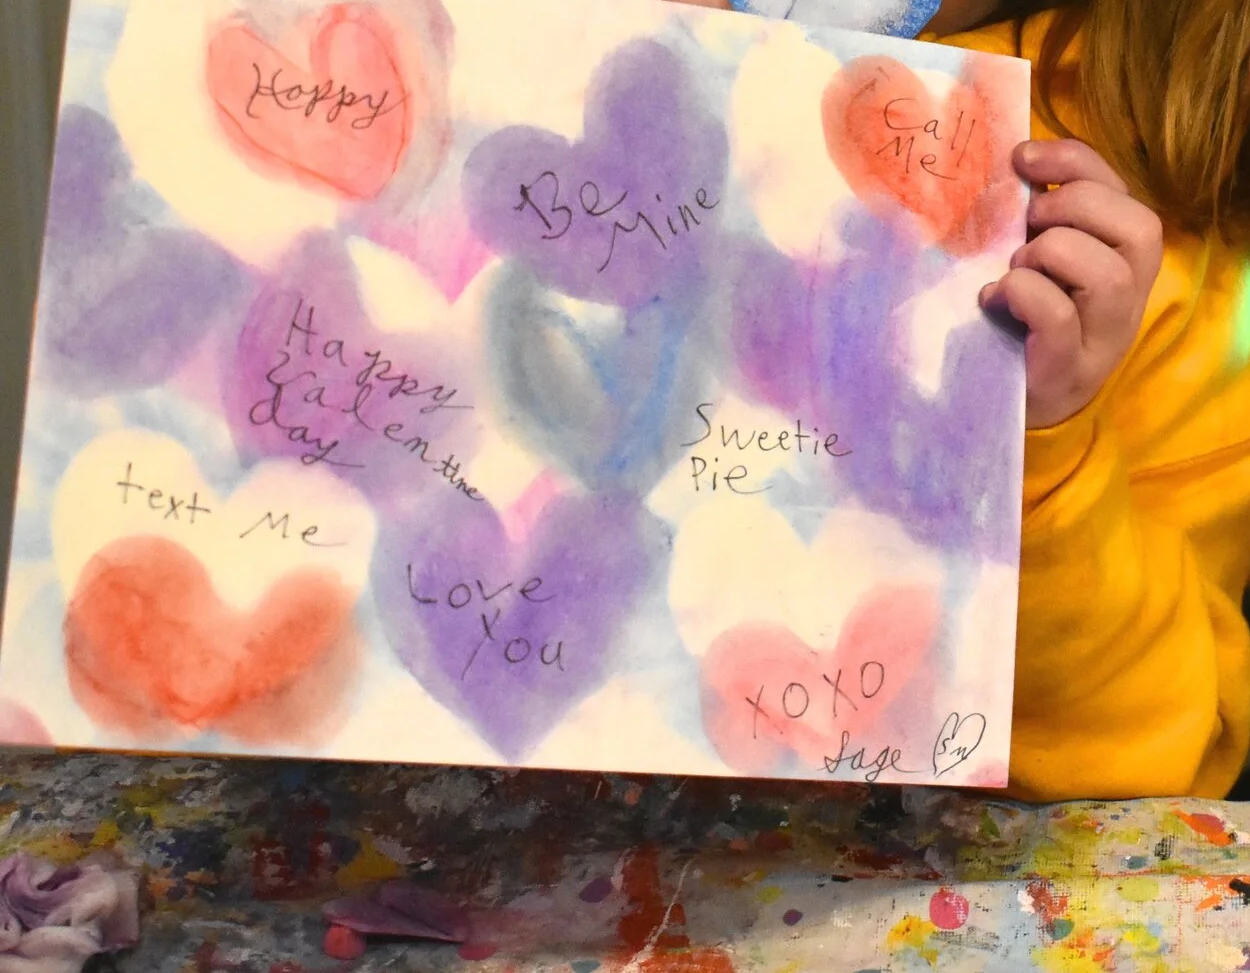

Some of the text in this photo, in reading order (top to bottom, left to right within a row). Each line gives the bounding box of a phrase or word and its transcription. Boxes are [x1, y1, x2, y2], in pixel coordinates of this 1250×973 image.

[245, 62, 409, 130] Happy
[875, 135, 960, 181] Me
[883, 97, 976, 168] Call
[513, 171, 629, 239] Be
[597, 183, 721, 274] Mine
[286, 298, 475, 414] Happy
[680, 402, 853, 457] Sweetie
[690, 456, 774, 494] Pie
[239, 512, 349, 548] Me
[817, 730, 937, 782] Sage
